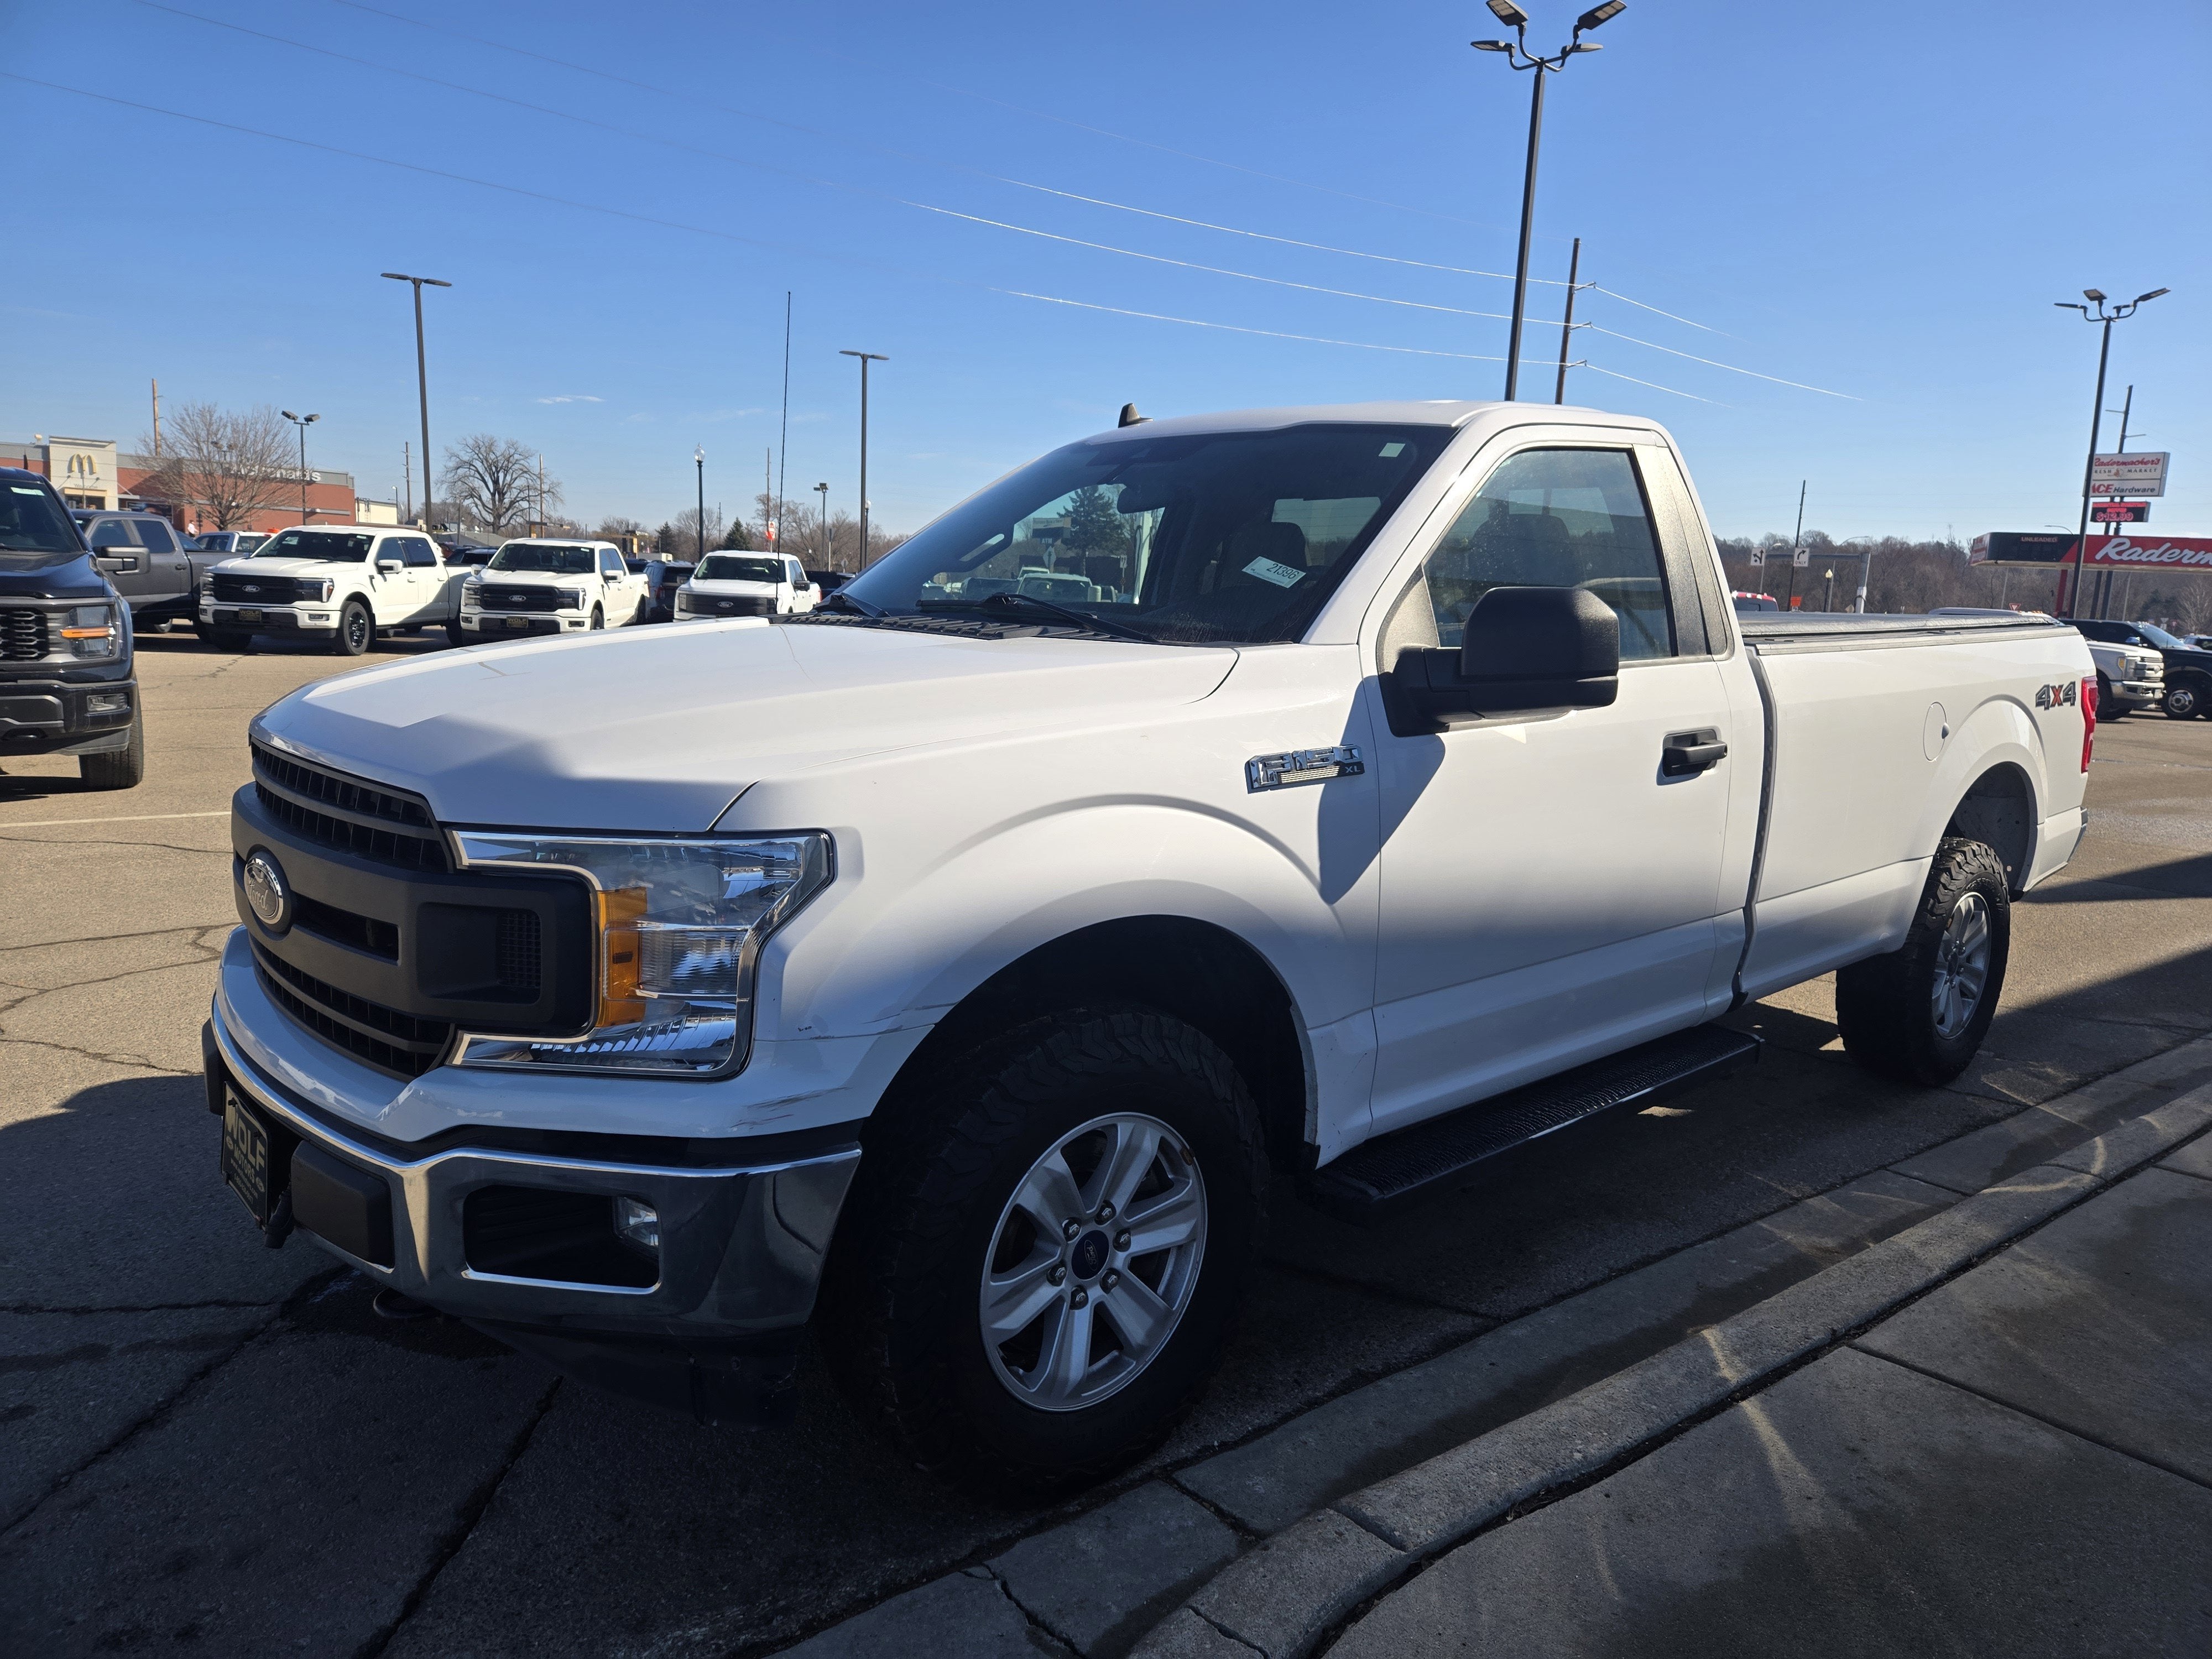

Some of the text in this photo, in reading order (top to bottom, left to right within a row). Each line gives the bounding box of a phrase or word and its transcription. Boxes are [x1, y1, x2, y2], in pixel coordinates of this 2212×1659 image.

[1266, 563, 1300, 579] 21396
[226, 1103, 265, 1171] WOLF
[233, 1143, 255, 1185] MOTORS
